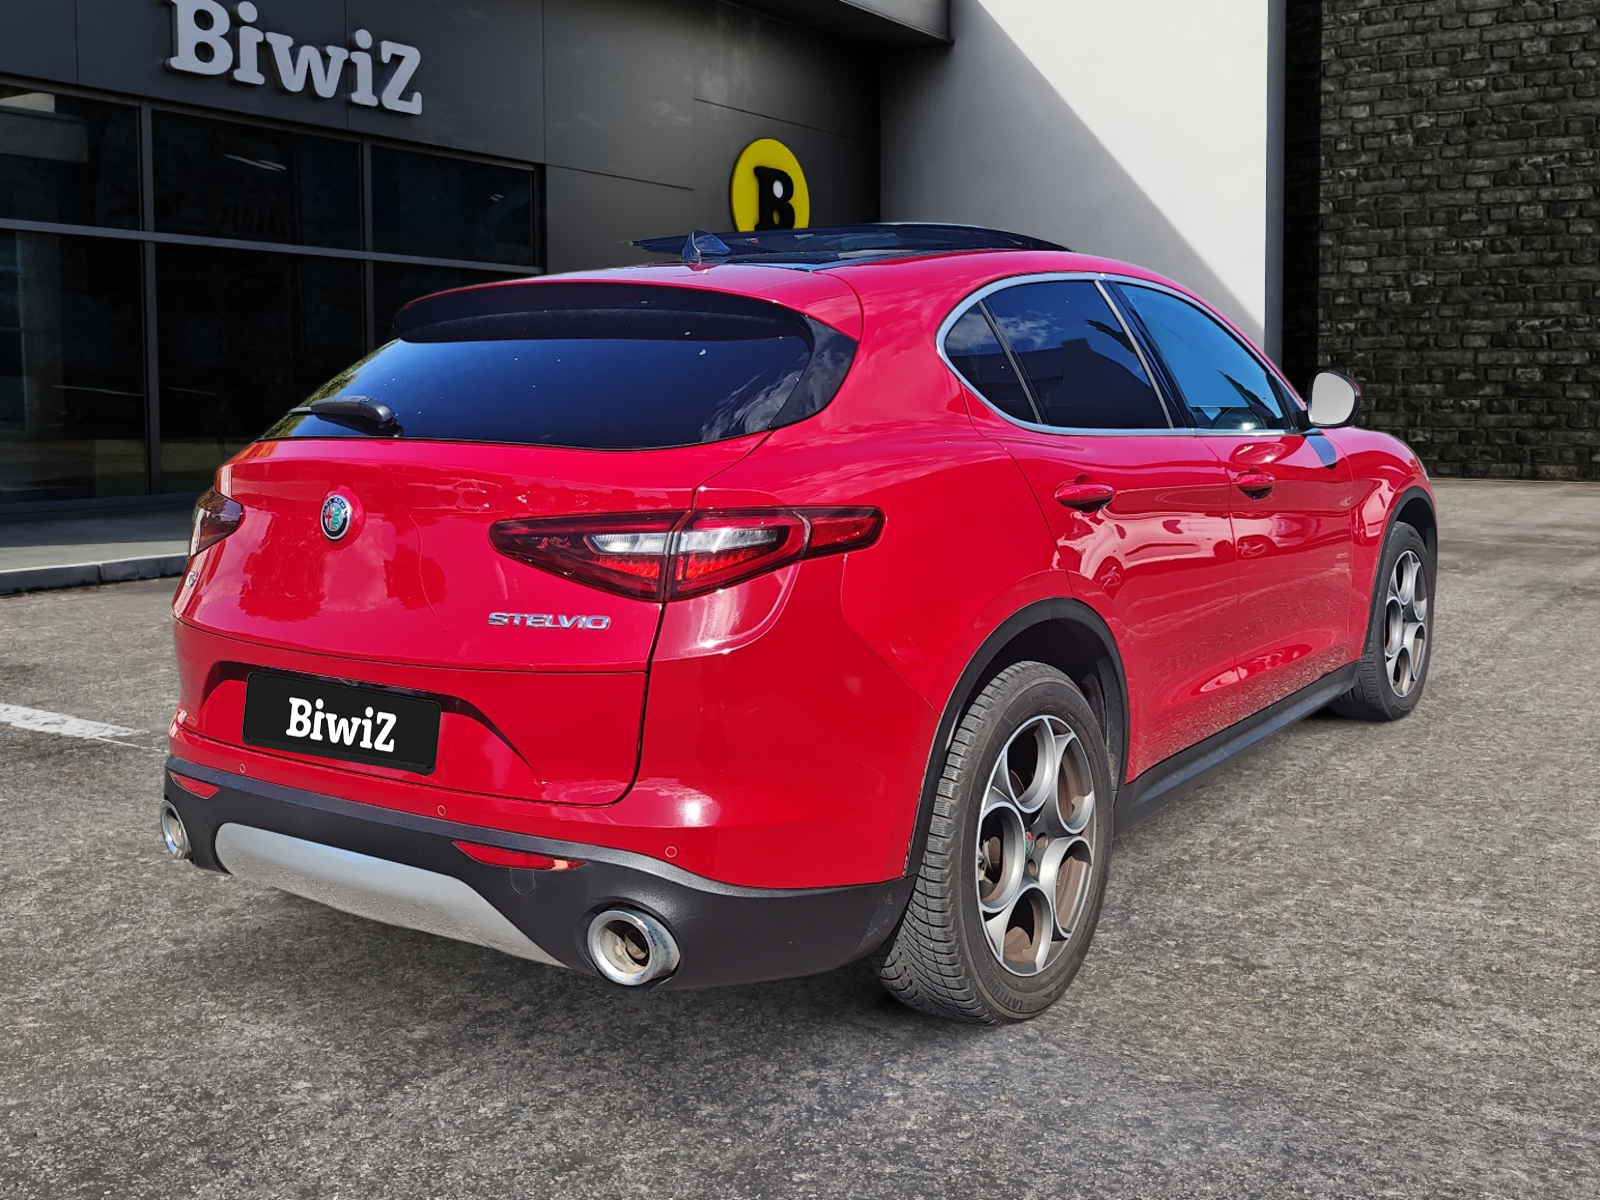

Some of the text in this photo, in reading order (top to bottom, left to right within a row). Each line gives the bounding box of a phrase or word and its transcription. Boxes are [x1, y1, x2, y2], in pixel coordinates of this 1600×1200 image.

[168, 0, 422, 115] BiwiZ
[753, 165, 796, 231] B
[488, 611, 611, 631] STELVIO
[285, 697, 397, 753] BiwiZ
